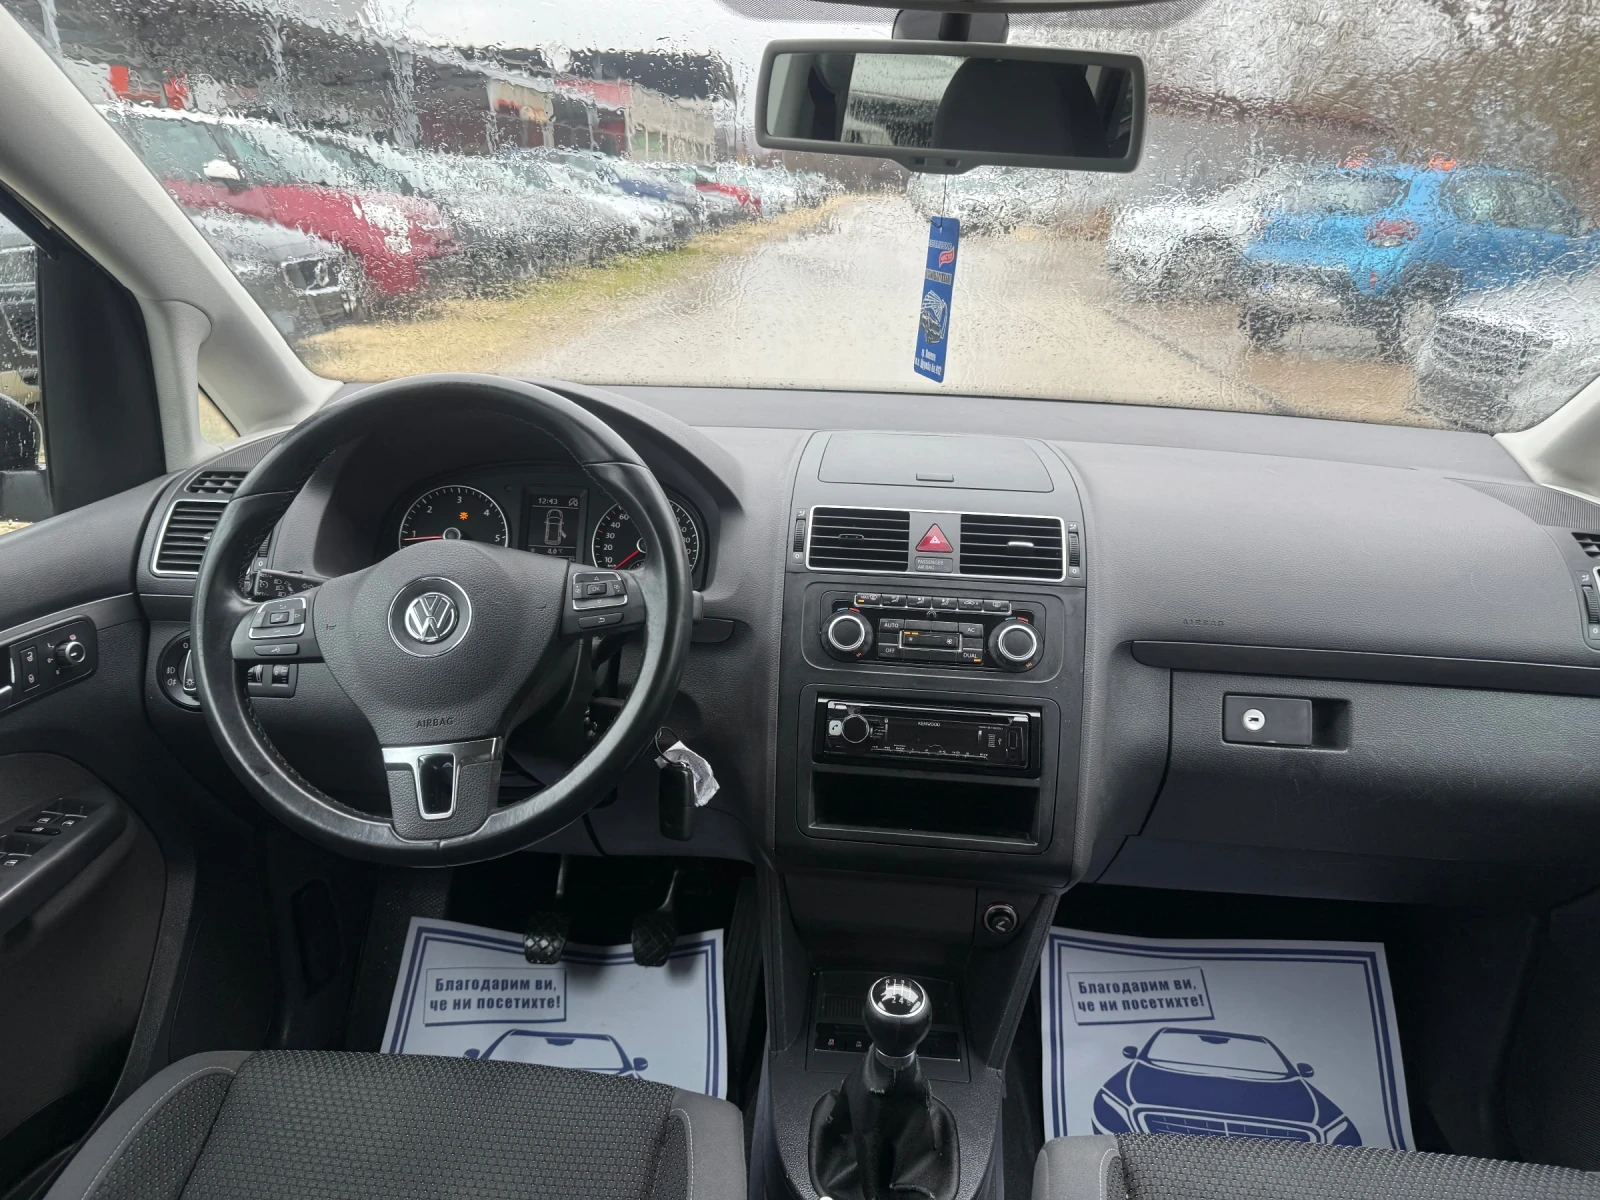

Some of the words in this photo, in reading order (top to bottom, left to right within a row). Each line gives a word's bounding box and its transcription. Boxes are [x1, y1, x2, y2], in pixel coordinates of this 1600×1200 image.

[456, 496, 462, 504] 3
[427, 505, 433, 514] 2
[483, 509, 490, 517] 4
[416, 717, 454, 728] AIRBAG
[435, 978, 530, 992] Благодарим
[535, 978, 557, 992] ви,
[1078, 979, 1170, 995] Благодарим
[1173, 978, 1197, 991] ви,
[430, 999, 447, 1011] че
[452, 998, 472, 1011] ни
[476, 995, 561, 1010] посетихте!
[891, 996, 896, 1004] 2
[898, 996, 904, 1005] 4
[1078, 1000, 1095, 1012] че
[1100, 999, 1118, 1012] ни
[1122, 994, 1205, 1010] посетихте!
